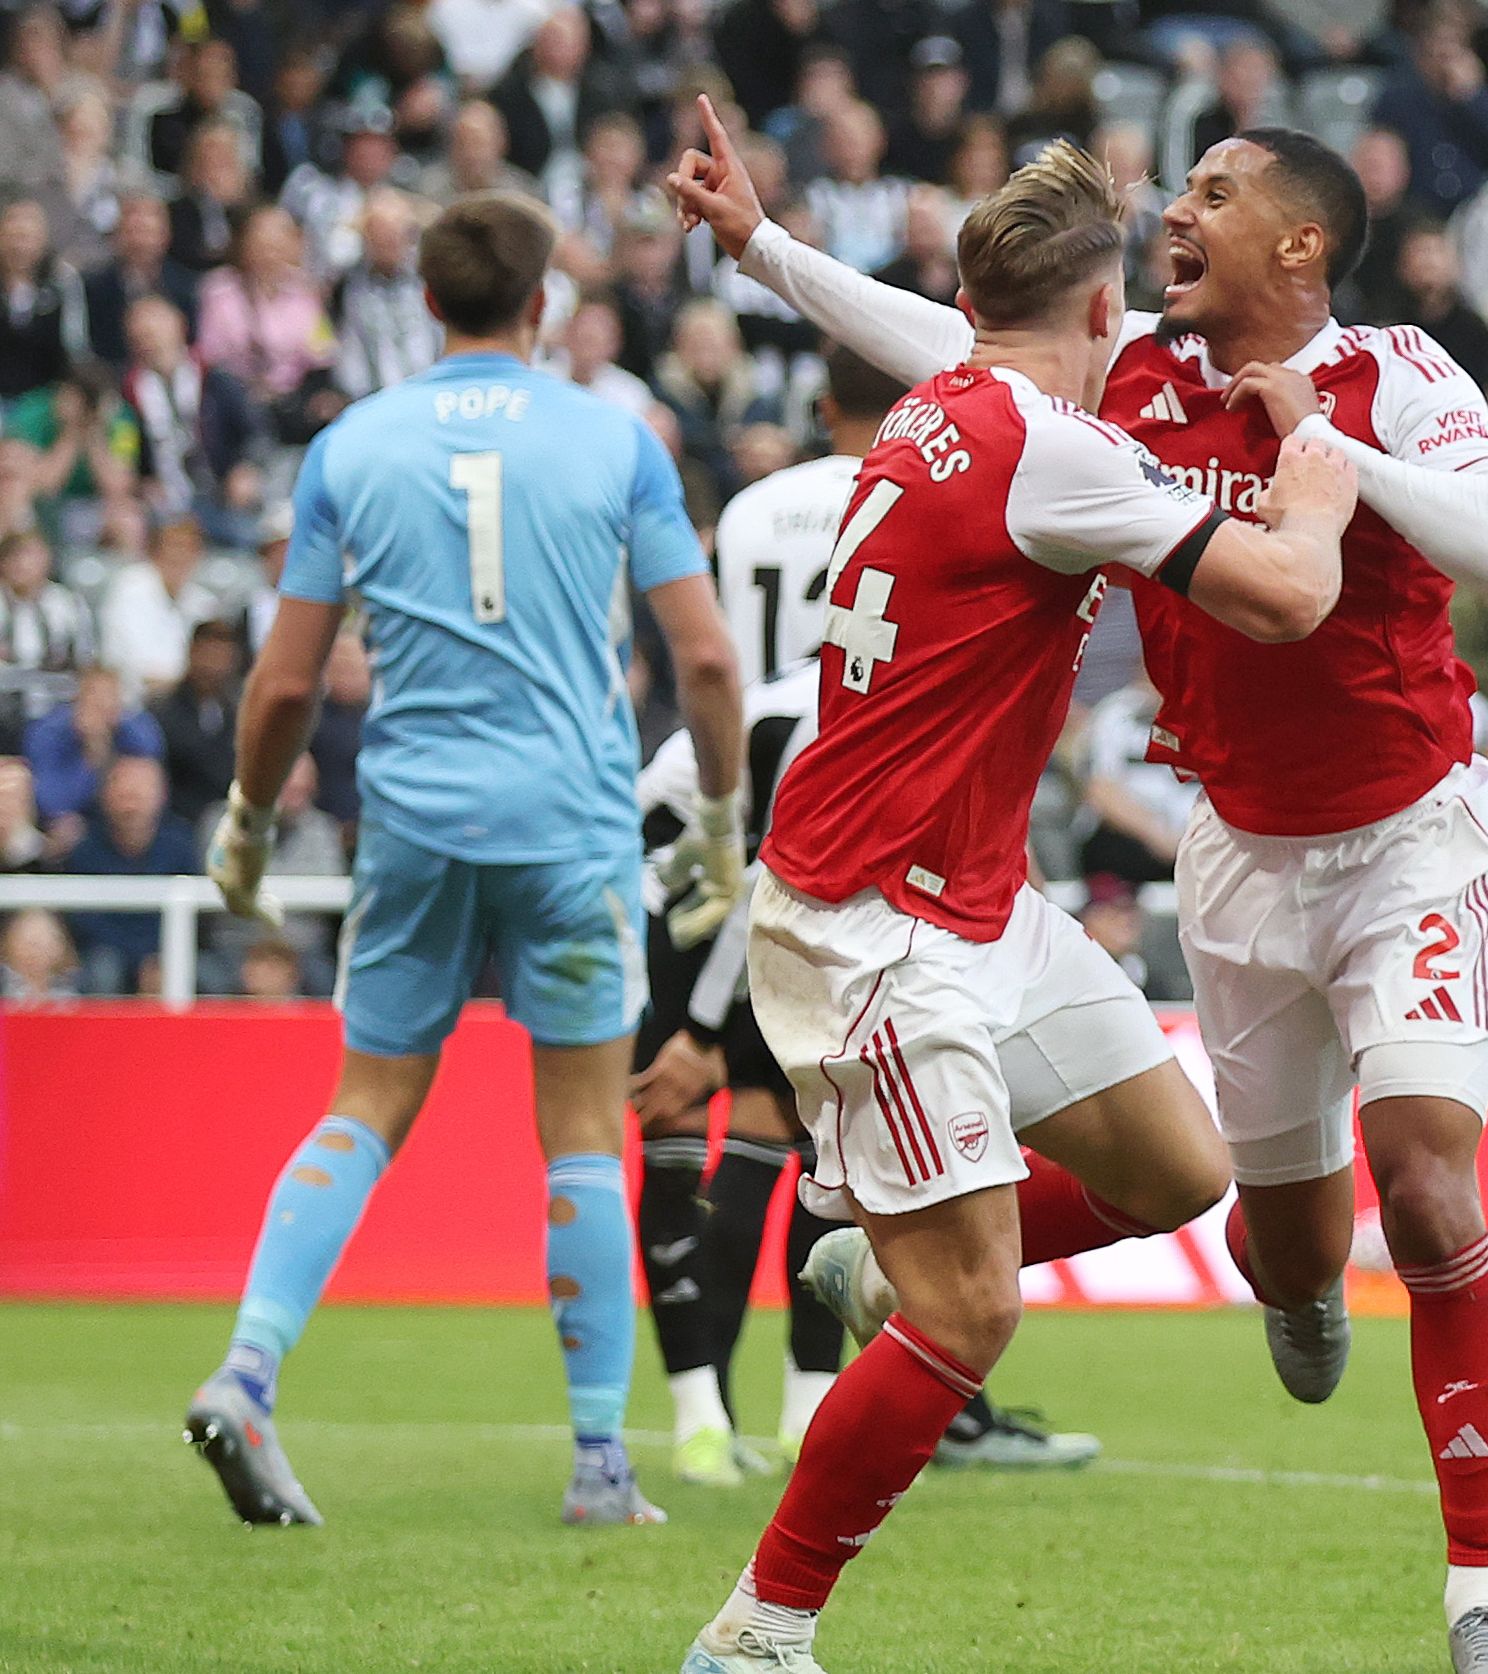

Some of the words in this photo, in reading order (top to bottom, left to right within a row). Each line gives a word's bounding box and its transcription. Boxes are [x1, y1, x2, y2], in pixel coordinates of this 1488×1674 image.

[434, 385, 532, 425] POPE
[1436, 410, 1480, 429] VISIT
[449, 451, 506, 624] 1
[822, 478, 904, 695] 4
[1413, 913, 1460, 980] 2
